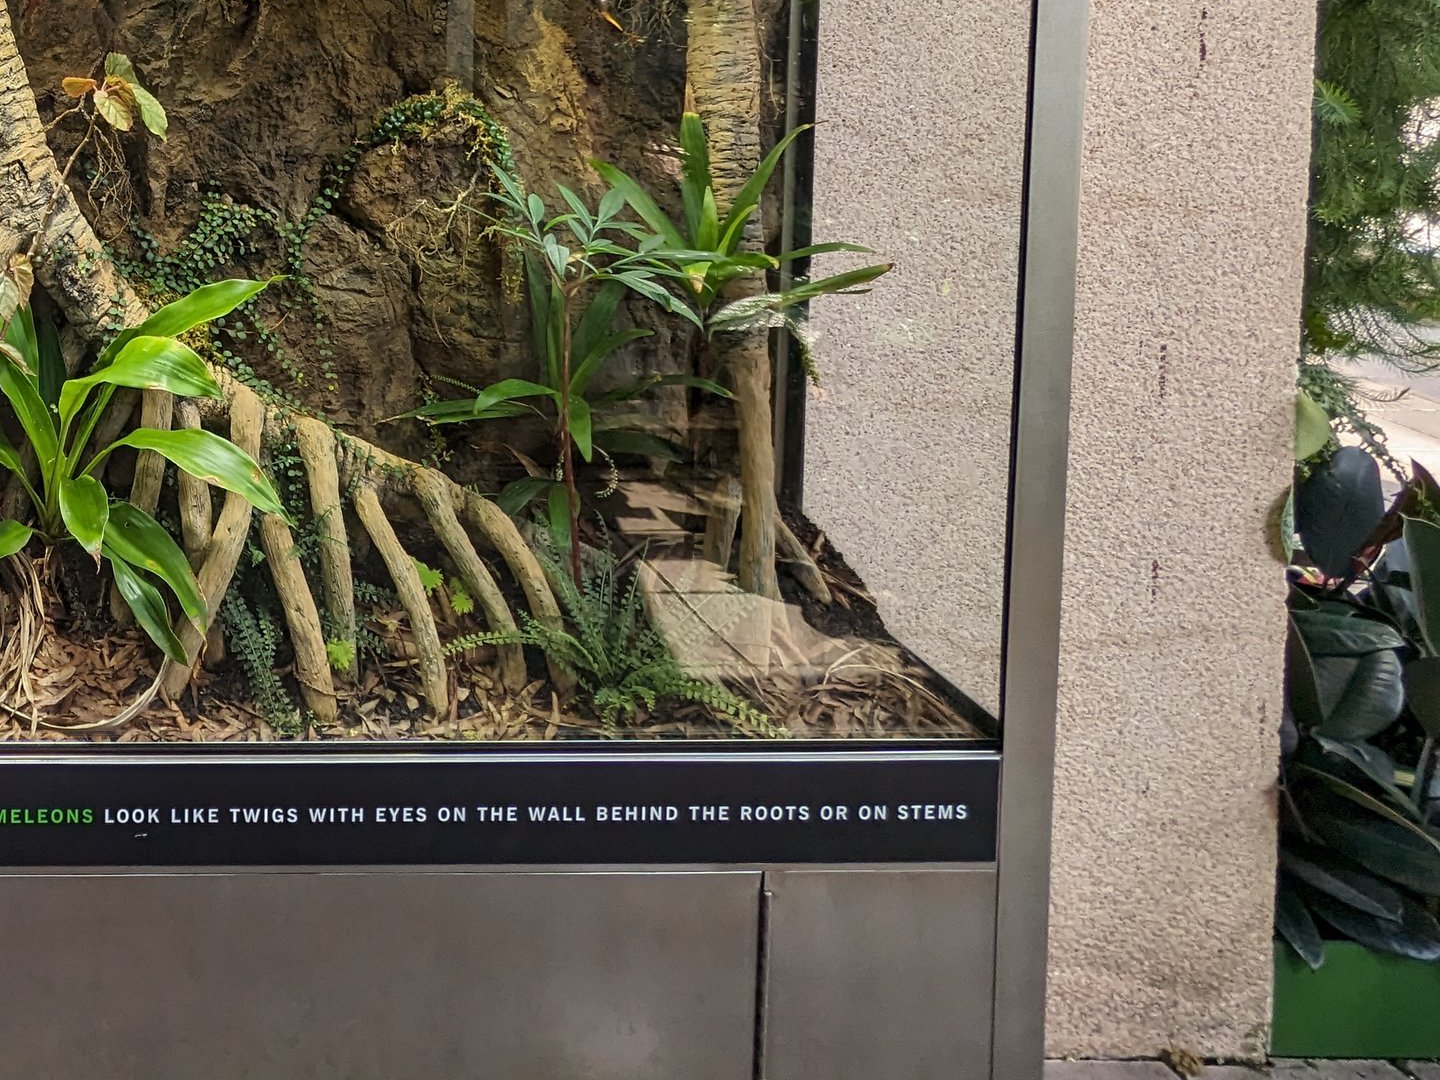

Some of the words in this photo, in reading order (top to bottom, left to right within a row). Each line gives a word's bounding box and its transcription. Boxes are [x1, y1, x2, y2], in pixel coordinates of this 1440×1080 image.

[104, 808, 159, 823] LOOK
[171, 808, 218, 823] LIKE
[229, 807, 298, 823] TWIGS
[308, 807, 364, 822] WITH
[375, 807, 426, 822] EYES
[437, 806, 466, 822] ON
[476, 806, 517, 821] THE
[528, 806, 585, 821] WALL
[596, 806, 678, 821] BEHIND
[688, 805, 729, 821] THE
[740, 805, 810, 821] ROOTS
[820, 805, 847, 820] OR
[858, 805, 886, 820] ON
[897, 804, 967, 820] STEMS
